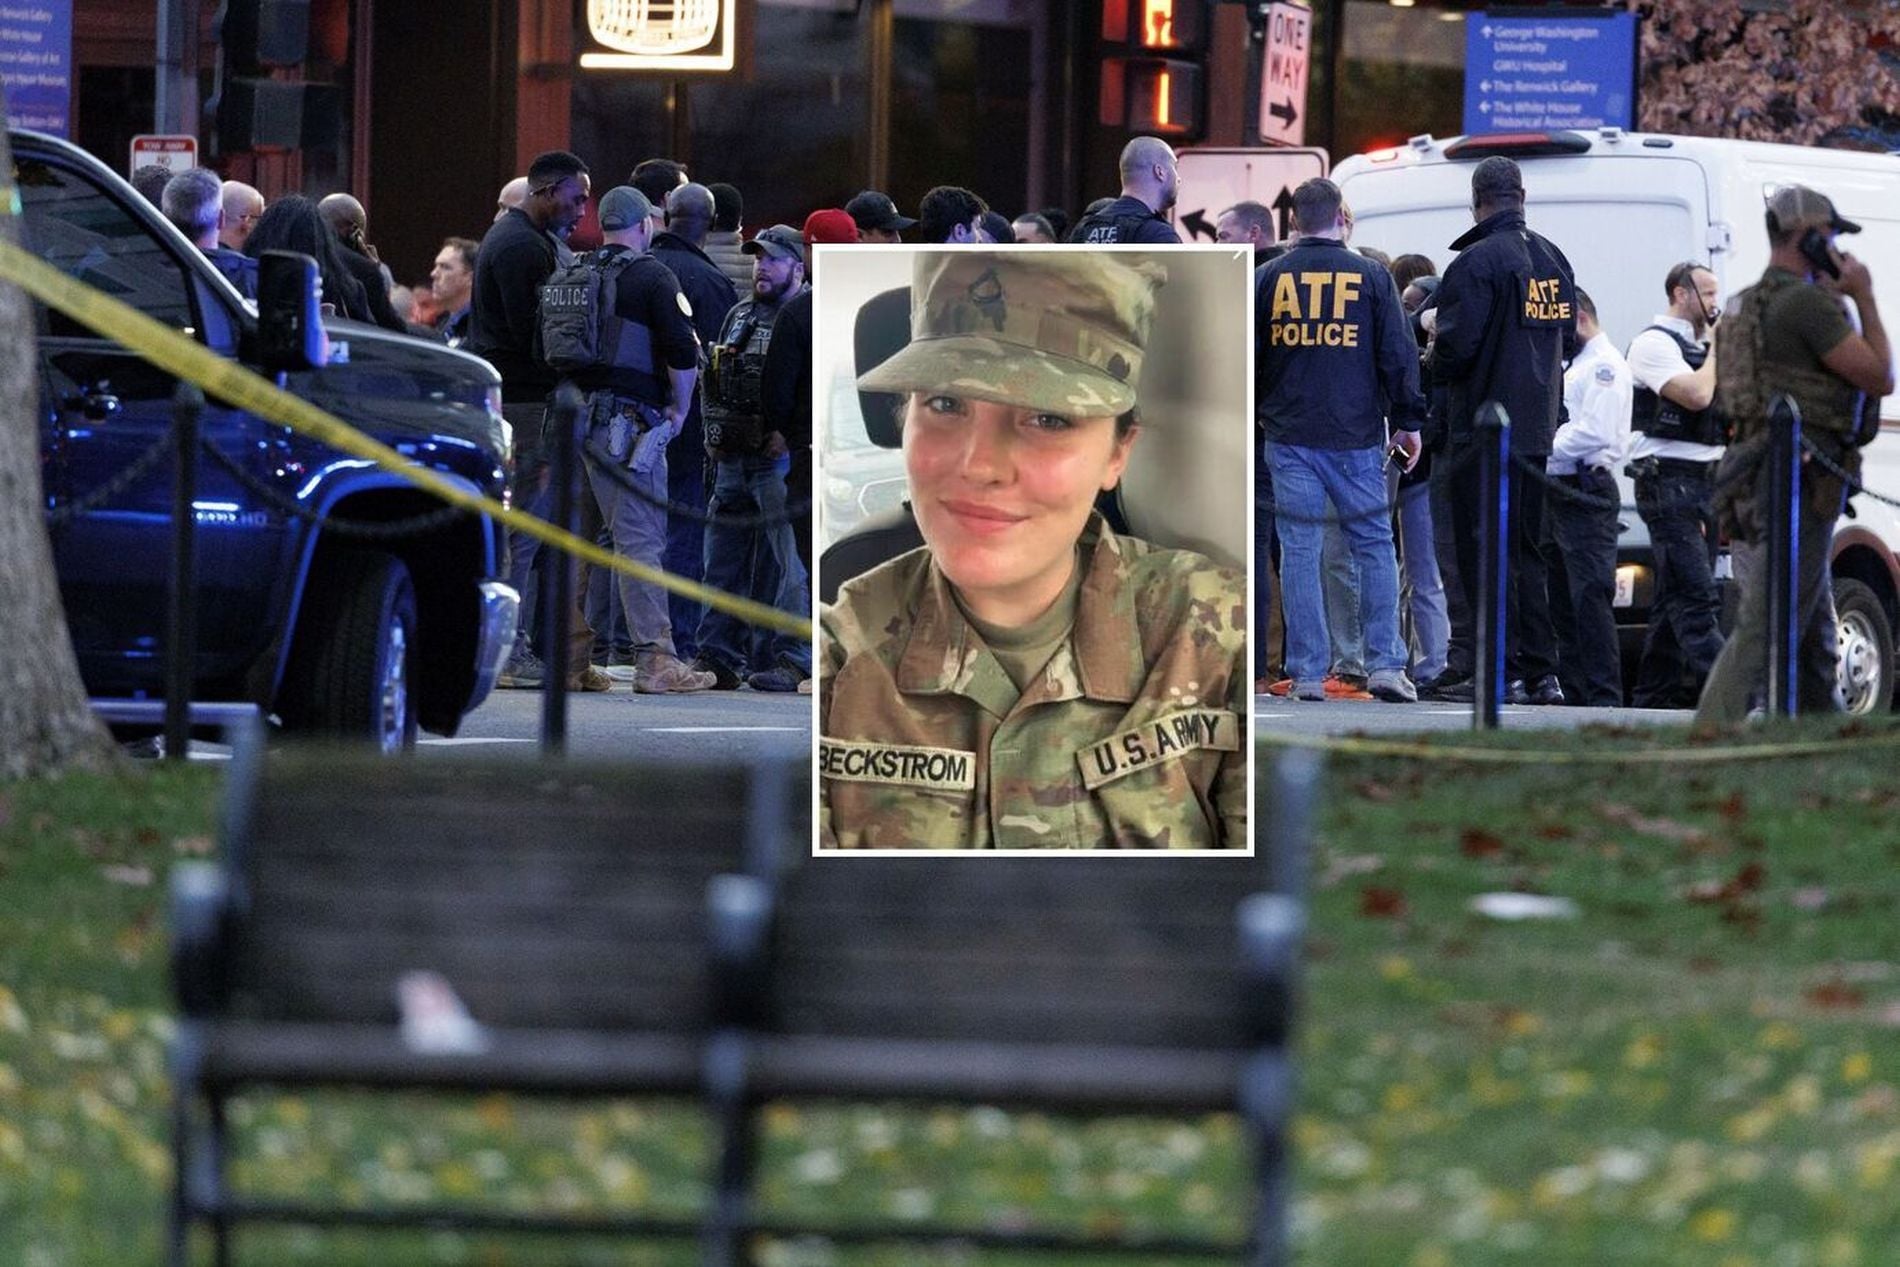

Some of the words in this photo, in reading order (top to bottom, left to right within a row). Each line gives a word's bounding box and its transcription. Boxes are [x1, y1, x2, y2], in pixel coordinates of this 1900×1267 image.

[1275, 13, 1305, 50] ONE
[1494, 26, 1533, 41] George
[1535, 27, 1600, 41] Washington
[1494, 42, 1548, 55] University
[1270, 52, 1303, 91] WAY
[1523, 60, 1568, 74] Hospital
[1493, 80, 1512, 92] The
[1560, 81, 1598, 97] Gallery
[1493, 101, 1512, 113] The
[1087, 226, 1118, 240] ATF
[545, 288, 589, 306] POLICE
[1271, 271, 1363, 320] ATF
[1528, 277, 1560, 303] ATF
[1525, 301, 1571, 320] POLICE
[1271, 322, 1359, 347] POLICE
[820, 745, 967, 782] BECKSTROM
